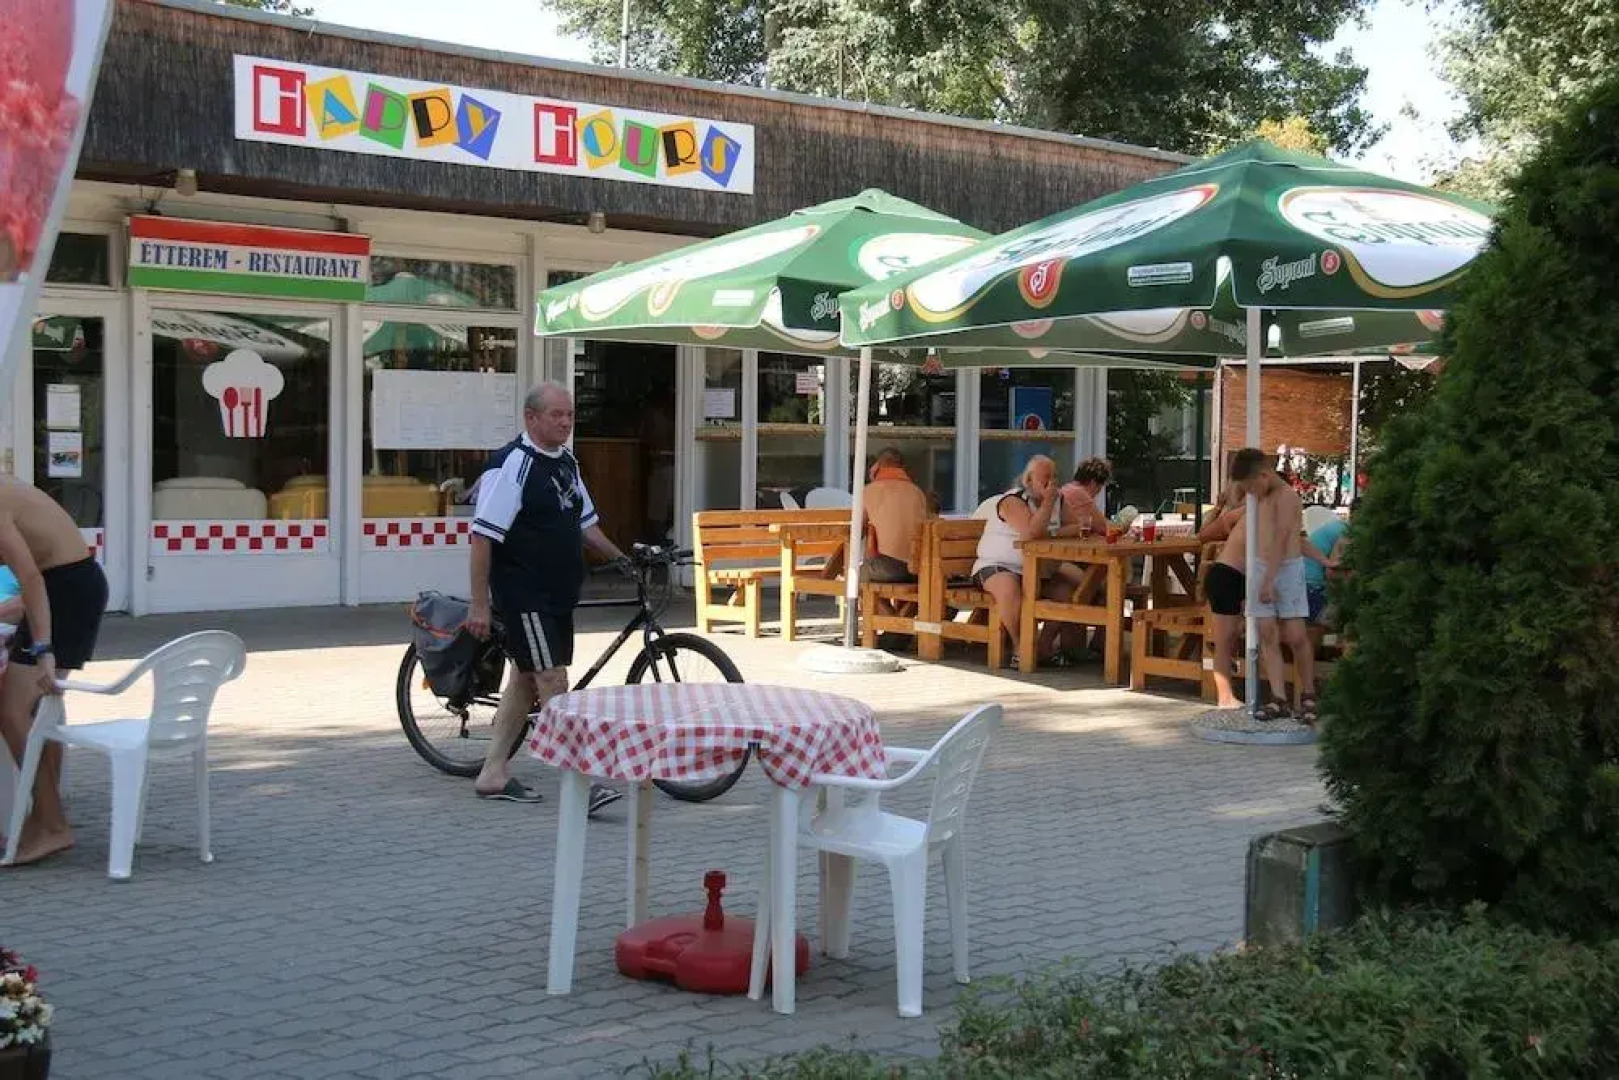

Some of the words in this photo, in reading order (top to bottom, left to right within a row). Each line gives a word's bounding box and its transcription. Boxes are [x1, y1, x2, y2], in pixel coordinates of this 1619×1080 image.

[254, 67, 500, 157] HAPPY
[535, 105, 740, 182] HOURS
[249, 252, 362, 278] RESTAURANT
[1256, 252, 1317, 294] Soproni
